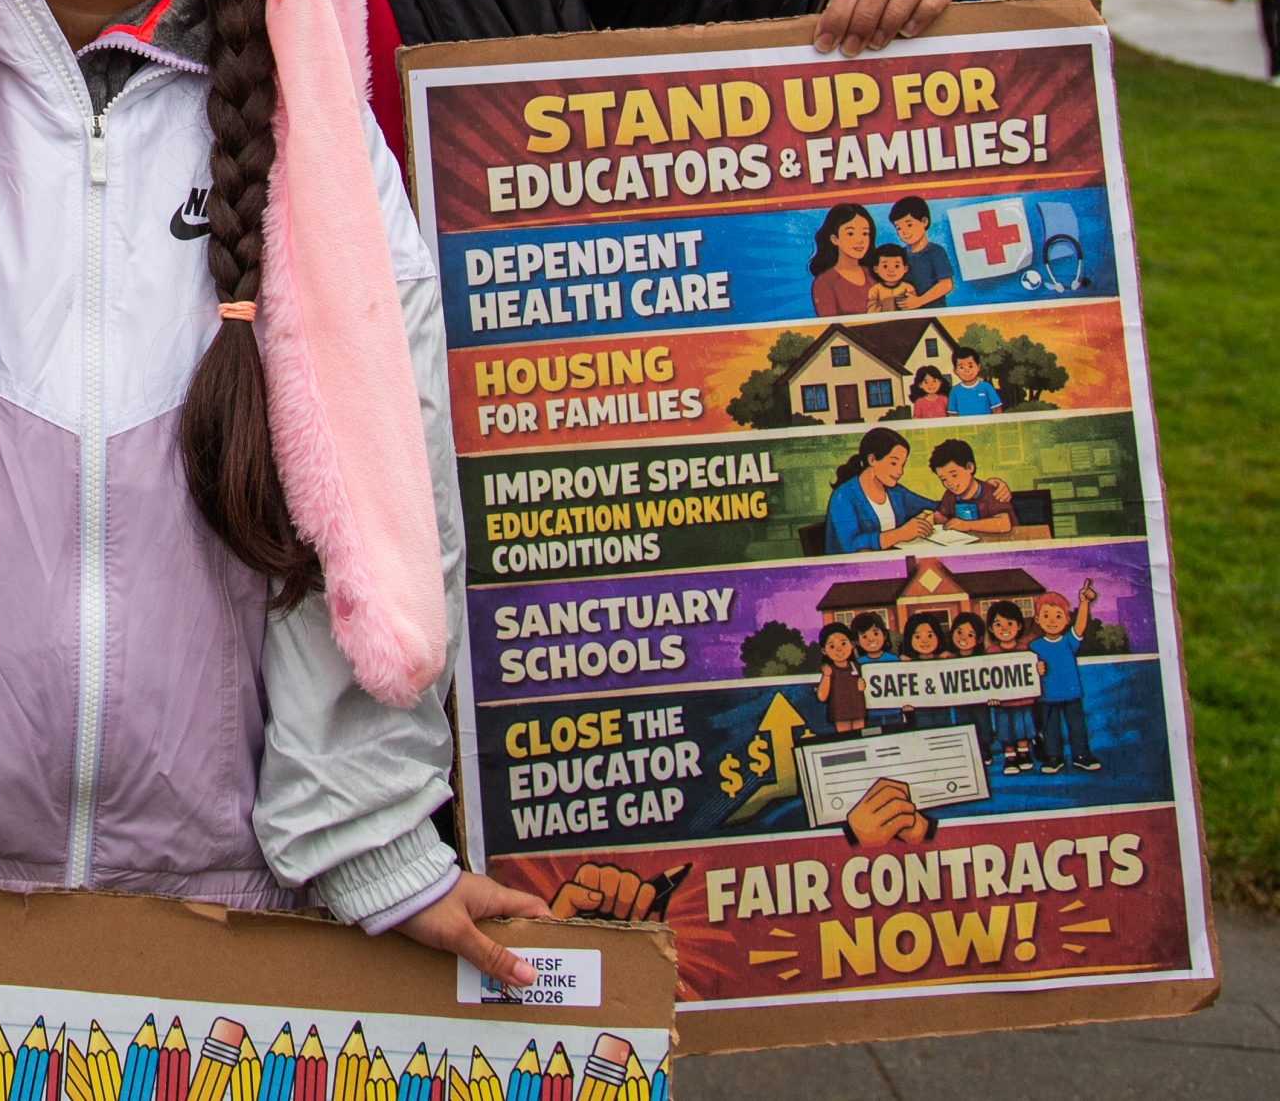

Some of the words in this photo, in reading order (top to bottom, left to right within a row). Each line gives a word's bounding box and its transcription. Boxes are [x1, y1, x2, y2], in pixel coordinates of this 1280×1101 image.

[523, 80, 771, 153] STAND
[783, 72, 880, 133] UP
[892, 67, 1000, 120] FOR
[486, 143, 771, 213] EDUCATORS
[779, 148, 801, 179] &
[806, 114, 1048, 184] FAMILIES!
[465, 229, 702, 286] DEPENDENT
[469, 280, 622, 332] HEALTH
[630, 271, 731, 317] CARE
[475, 346, 674, 397] HOUSING
[478, 401, 539, 435] FOR
[545, 388, 703, 430] FAMILIES
[483, 461, 641, 506] IMPROVE
[647, 451, 779, 493] SPECIAL
[486, 502, 631, 541] EDUCATION
[635, 490, 768, 528] WORKING
[492, 532, 661, 574] CONDITIONS
[494, 588, 734, 640] SANCTUARY
[500, 634, 686, 683] SCHOOLS
[869, 672, 919, 698] SAFE
[924, 678, 937, 695] &
[939, 663, 1034, 695] WELCOME
[505, 708, 623, 759] CLOSE
[627, 706, 684, 741] THE
[508, 740, 703, 801] EDUCATOR
[511, 796, 609, 840] WAGE
[616, 787, 684, 828] GAP
[705, 859, 832, 923] FAIR
[841, 833, 1144, 909] CONTRACTS
[819, 901, 1038, 980] NOW!
[524, 989, 564, 1004] 2026
[528, 974, 577, 987] TRIKE
